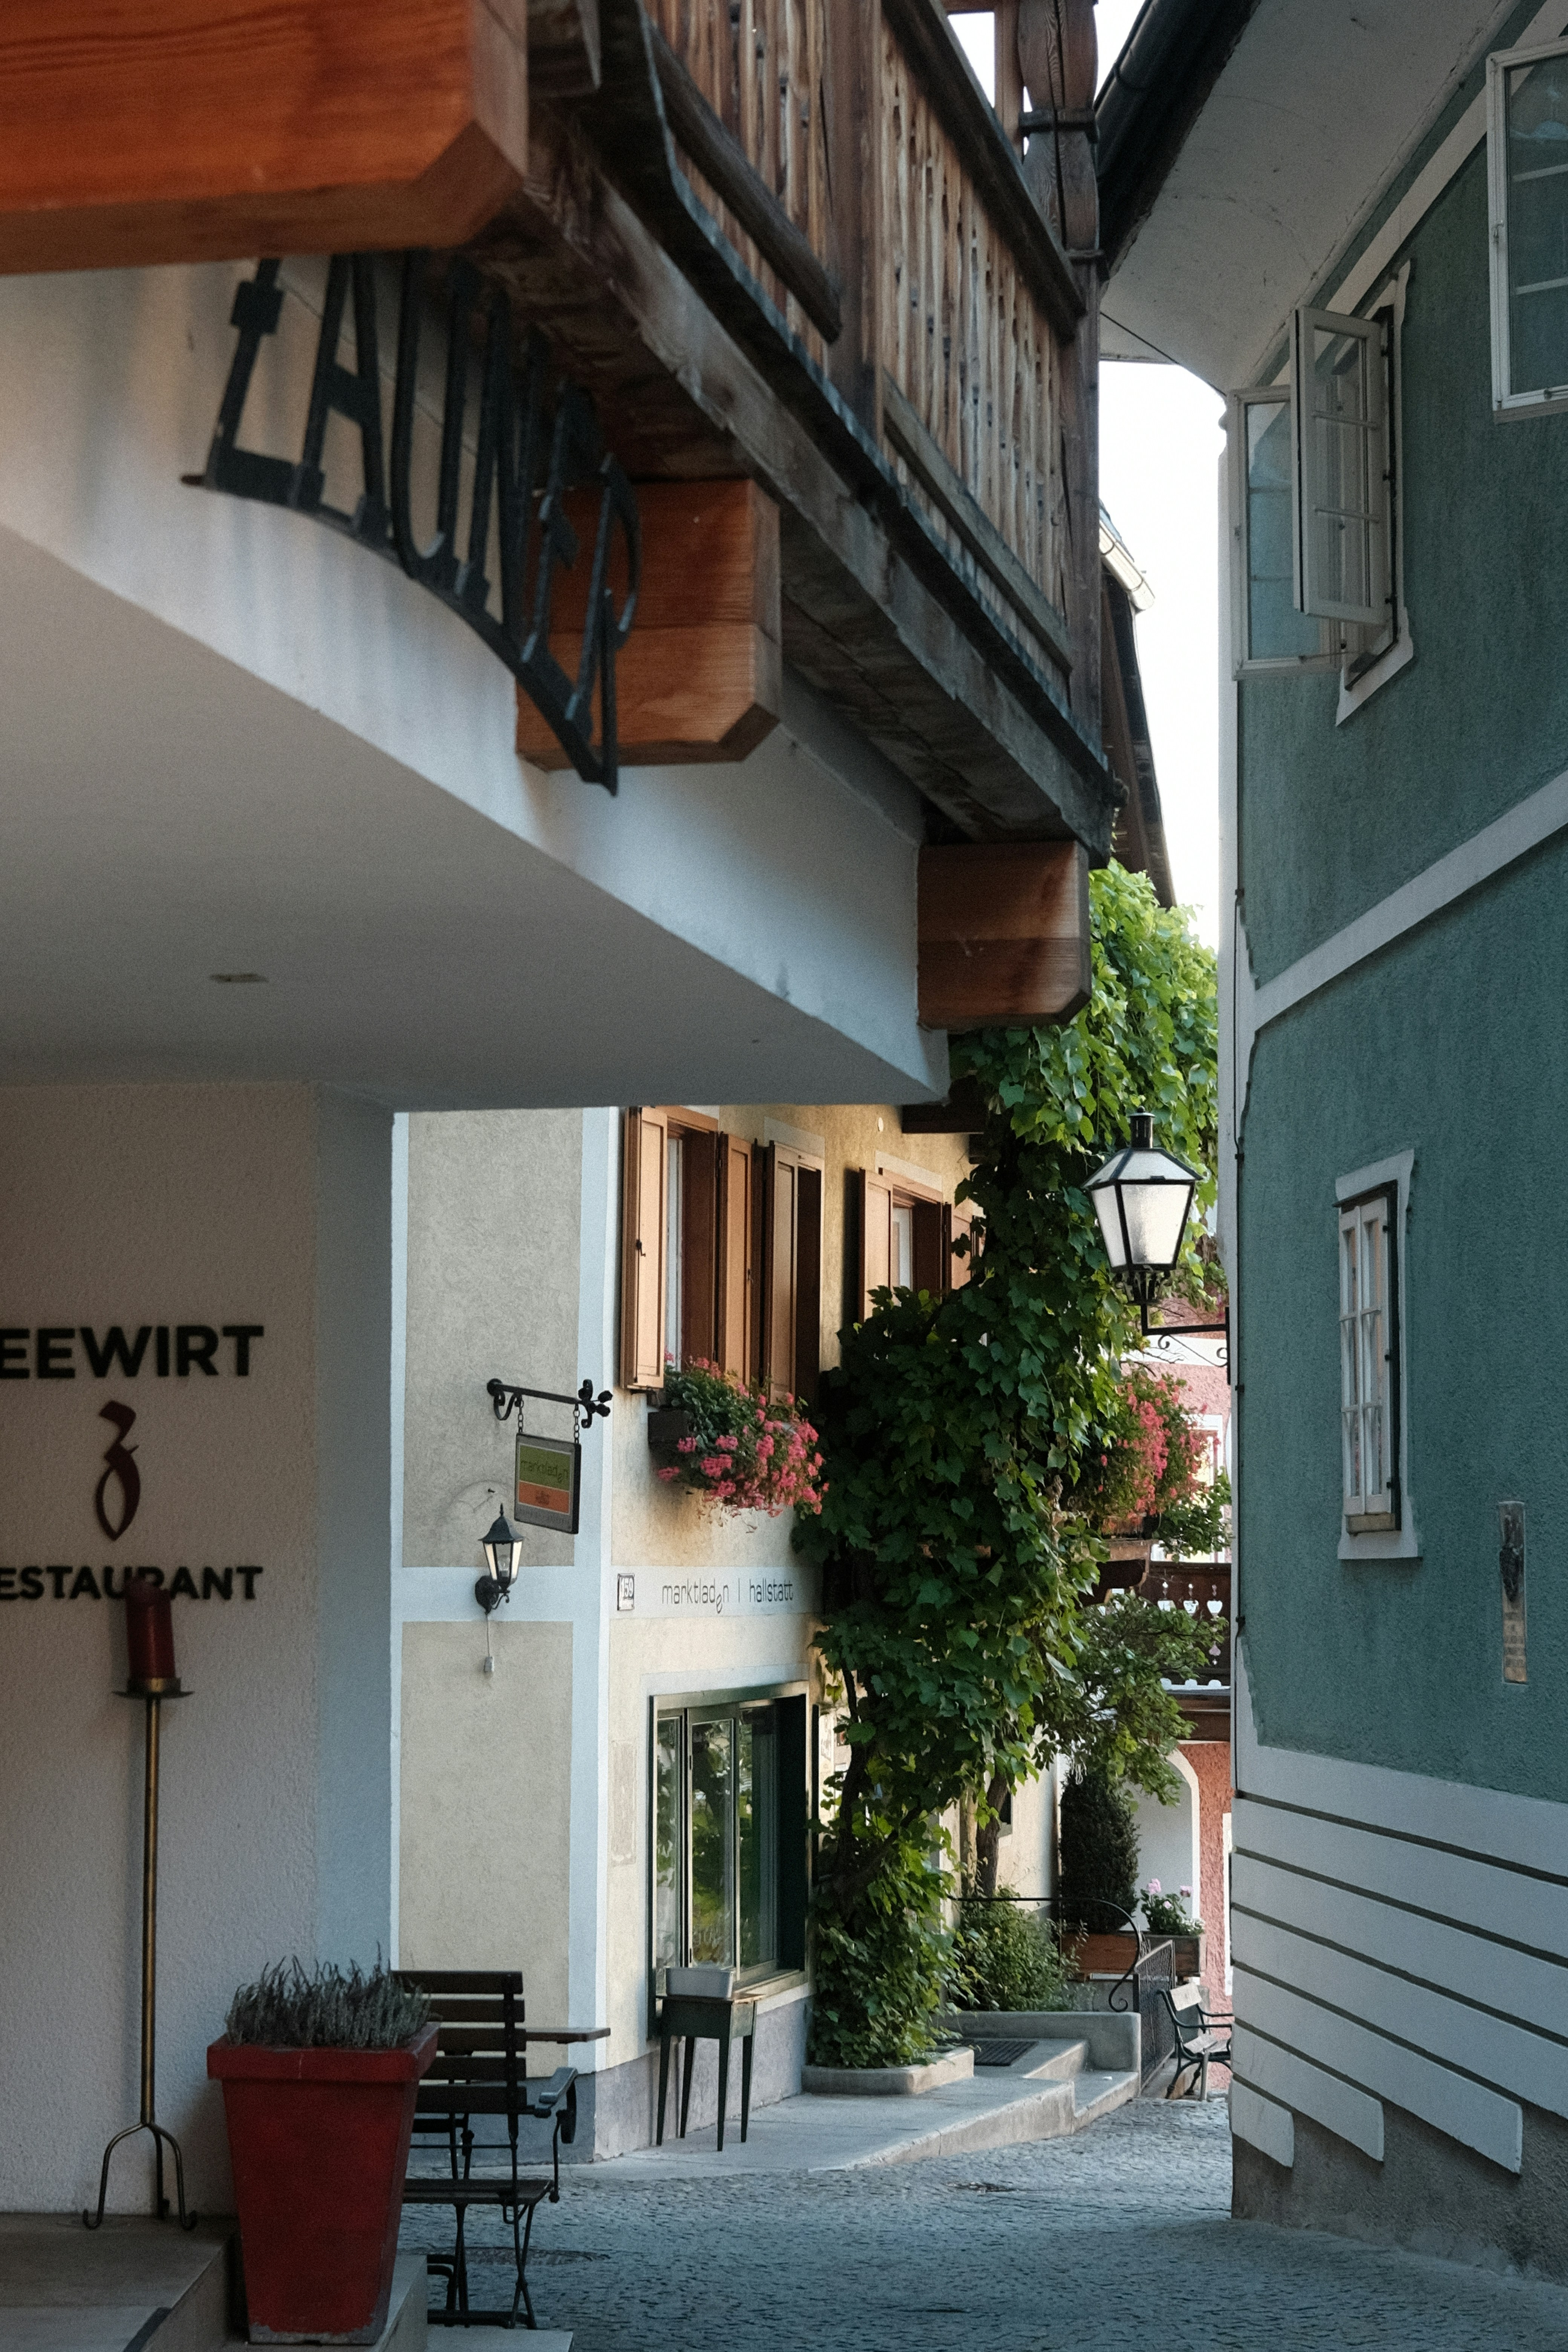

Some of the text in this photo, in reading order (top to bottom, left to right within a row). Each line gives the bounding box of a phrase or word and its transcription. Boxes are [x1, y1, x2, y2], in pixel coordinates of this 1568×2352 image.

[620, 1577, 634, 1597] 159
[662, 1578, 729, 1614] marktladen
[749, 1578, 793, 1603] hallstatt
